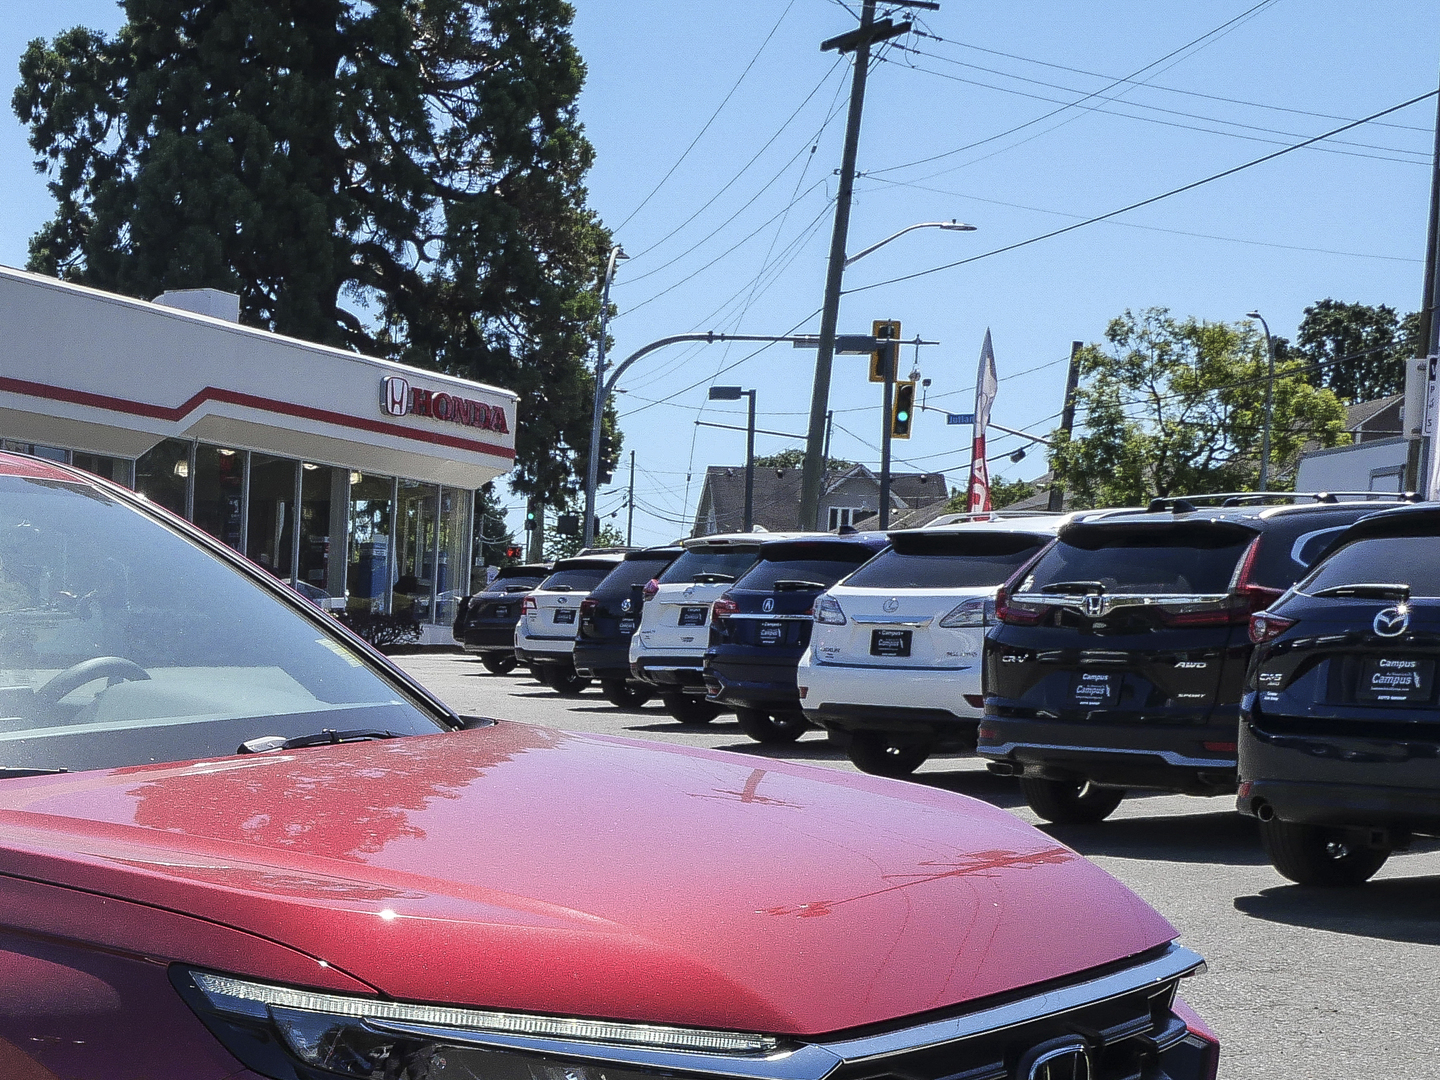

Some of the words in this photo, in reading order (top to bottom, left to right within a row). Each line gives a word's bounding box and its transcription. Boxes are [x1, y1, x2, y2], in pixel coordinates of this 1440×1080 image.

[410, 386, 510, 435] HONDA
[1174, 661, 1207, 669] AWD
[1380, 658, 1416, 669] Campus
[1082, 673, 1109, 682] Campus
[1372, 672, 1412, 687] Campus
[1076, 685, 1105, 696] Campus
